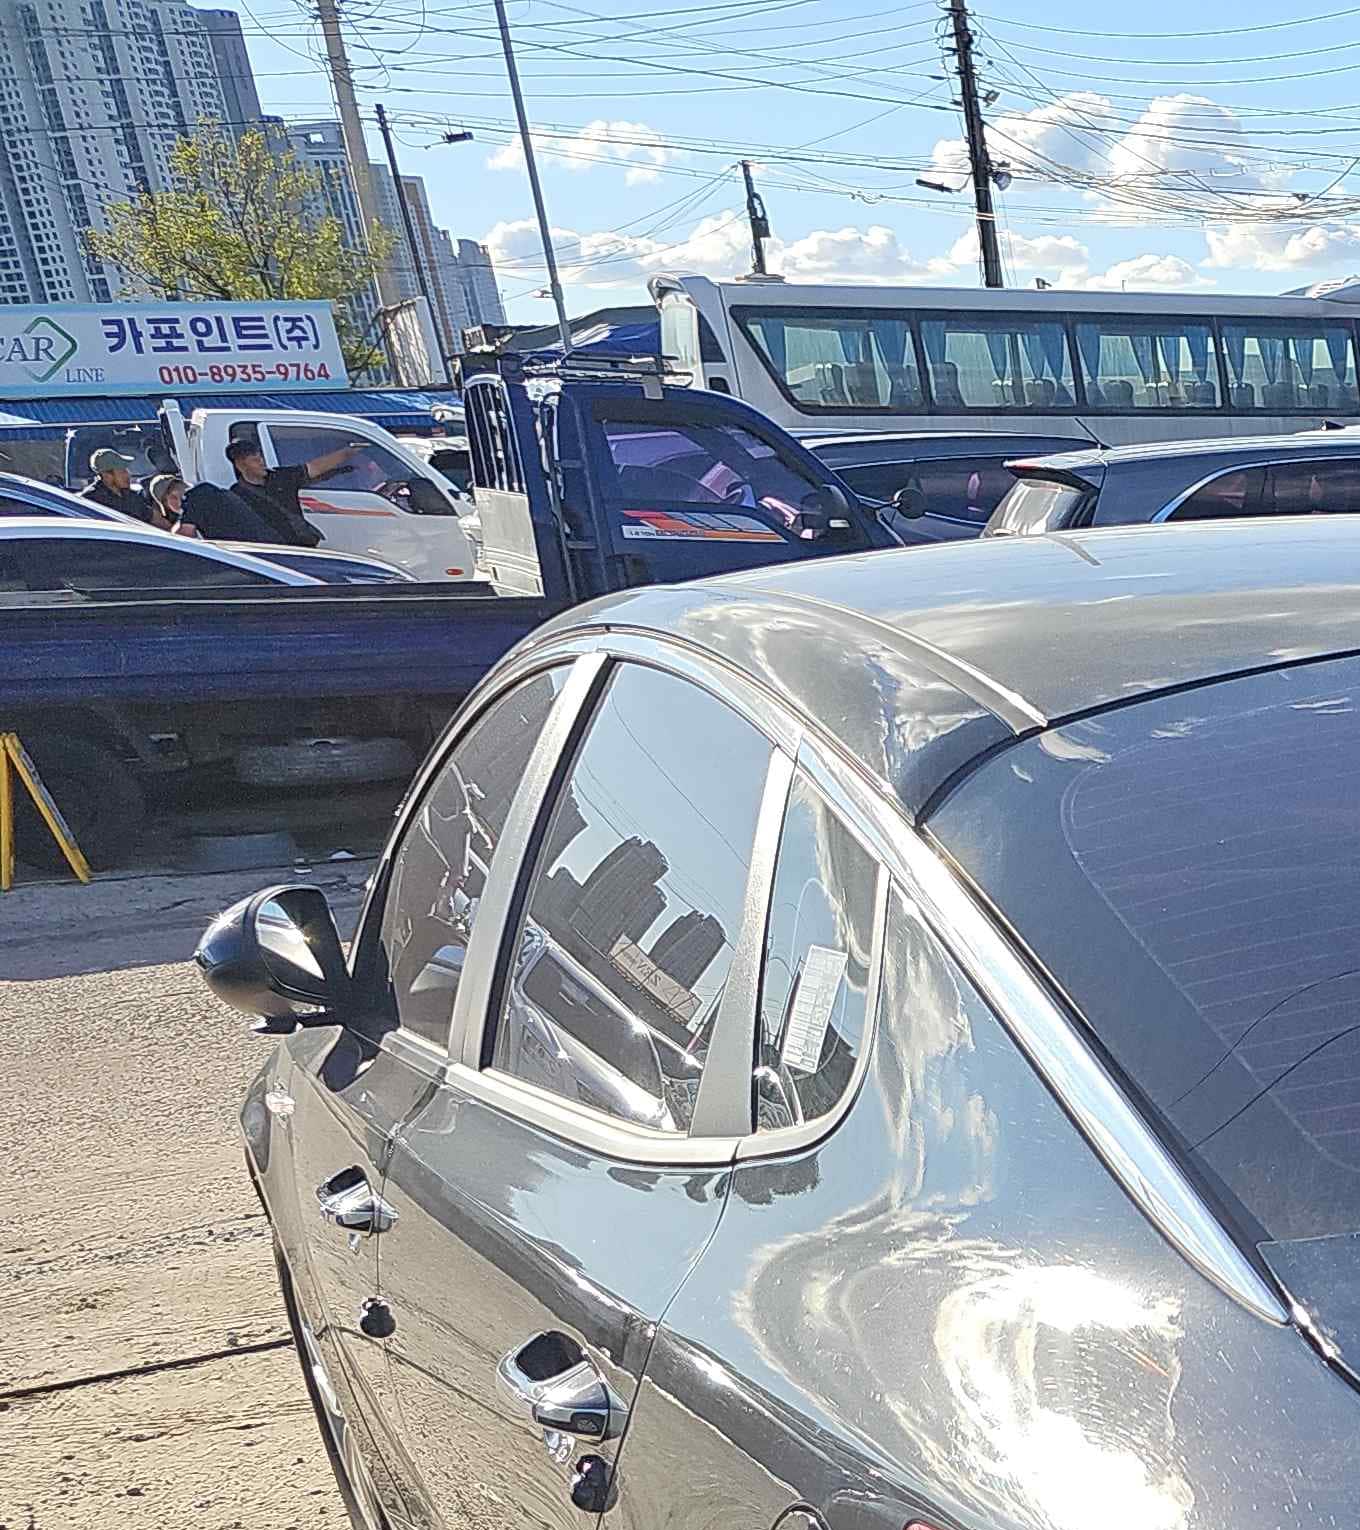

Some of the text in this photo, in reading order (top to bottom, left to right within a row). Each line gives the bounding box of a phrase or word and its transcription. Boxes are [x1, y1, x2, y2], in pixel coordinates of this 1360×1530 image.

[100, 314, 321, 355] 카포인트(주)
[0, 336, 57, 362] AR
[65, 368, 105, 383] LINE
[158, 363, 331, 385] 010-8935-9764
